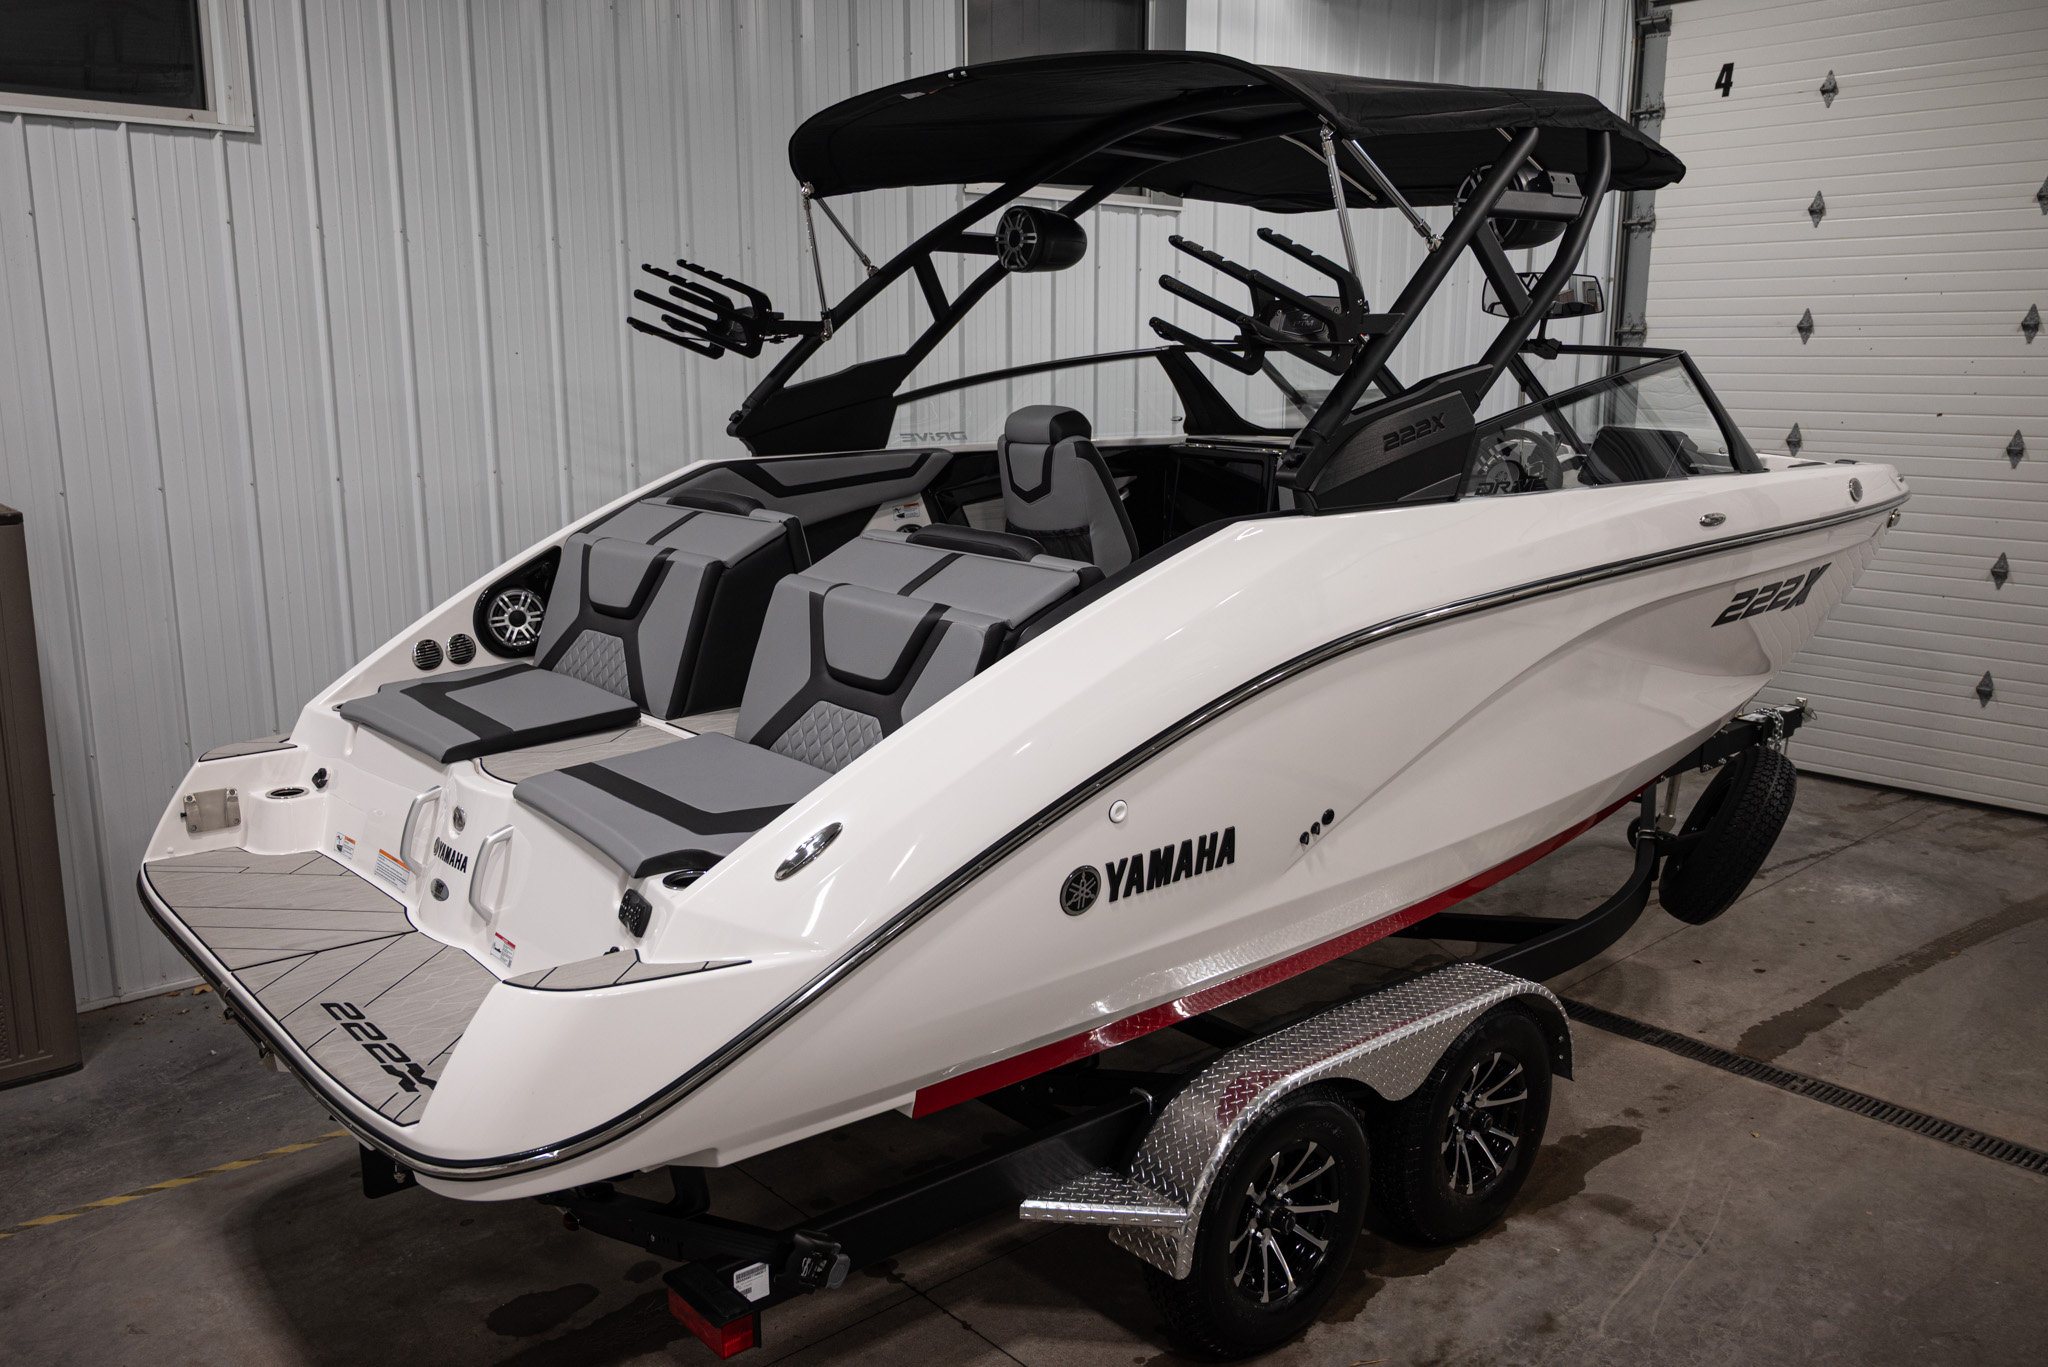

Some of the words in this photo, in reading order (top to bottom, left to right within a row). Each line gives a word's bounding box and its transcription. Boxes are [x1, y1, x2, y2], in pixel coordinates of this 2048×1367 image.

[1714, 61, 1735, 98] 4
[1382, 412, 1447, 453] 222X
[1710, 562, 1833, 628] 222X
[437, 840, 469, 874] YAMAHA
[1105, 826, 1236, 903] YAMAHA
[320, 1002, 438, 1093] 222X
